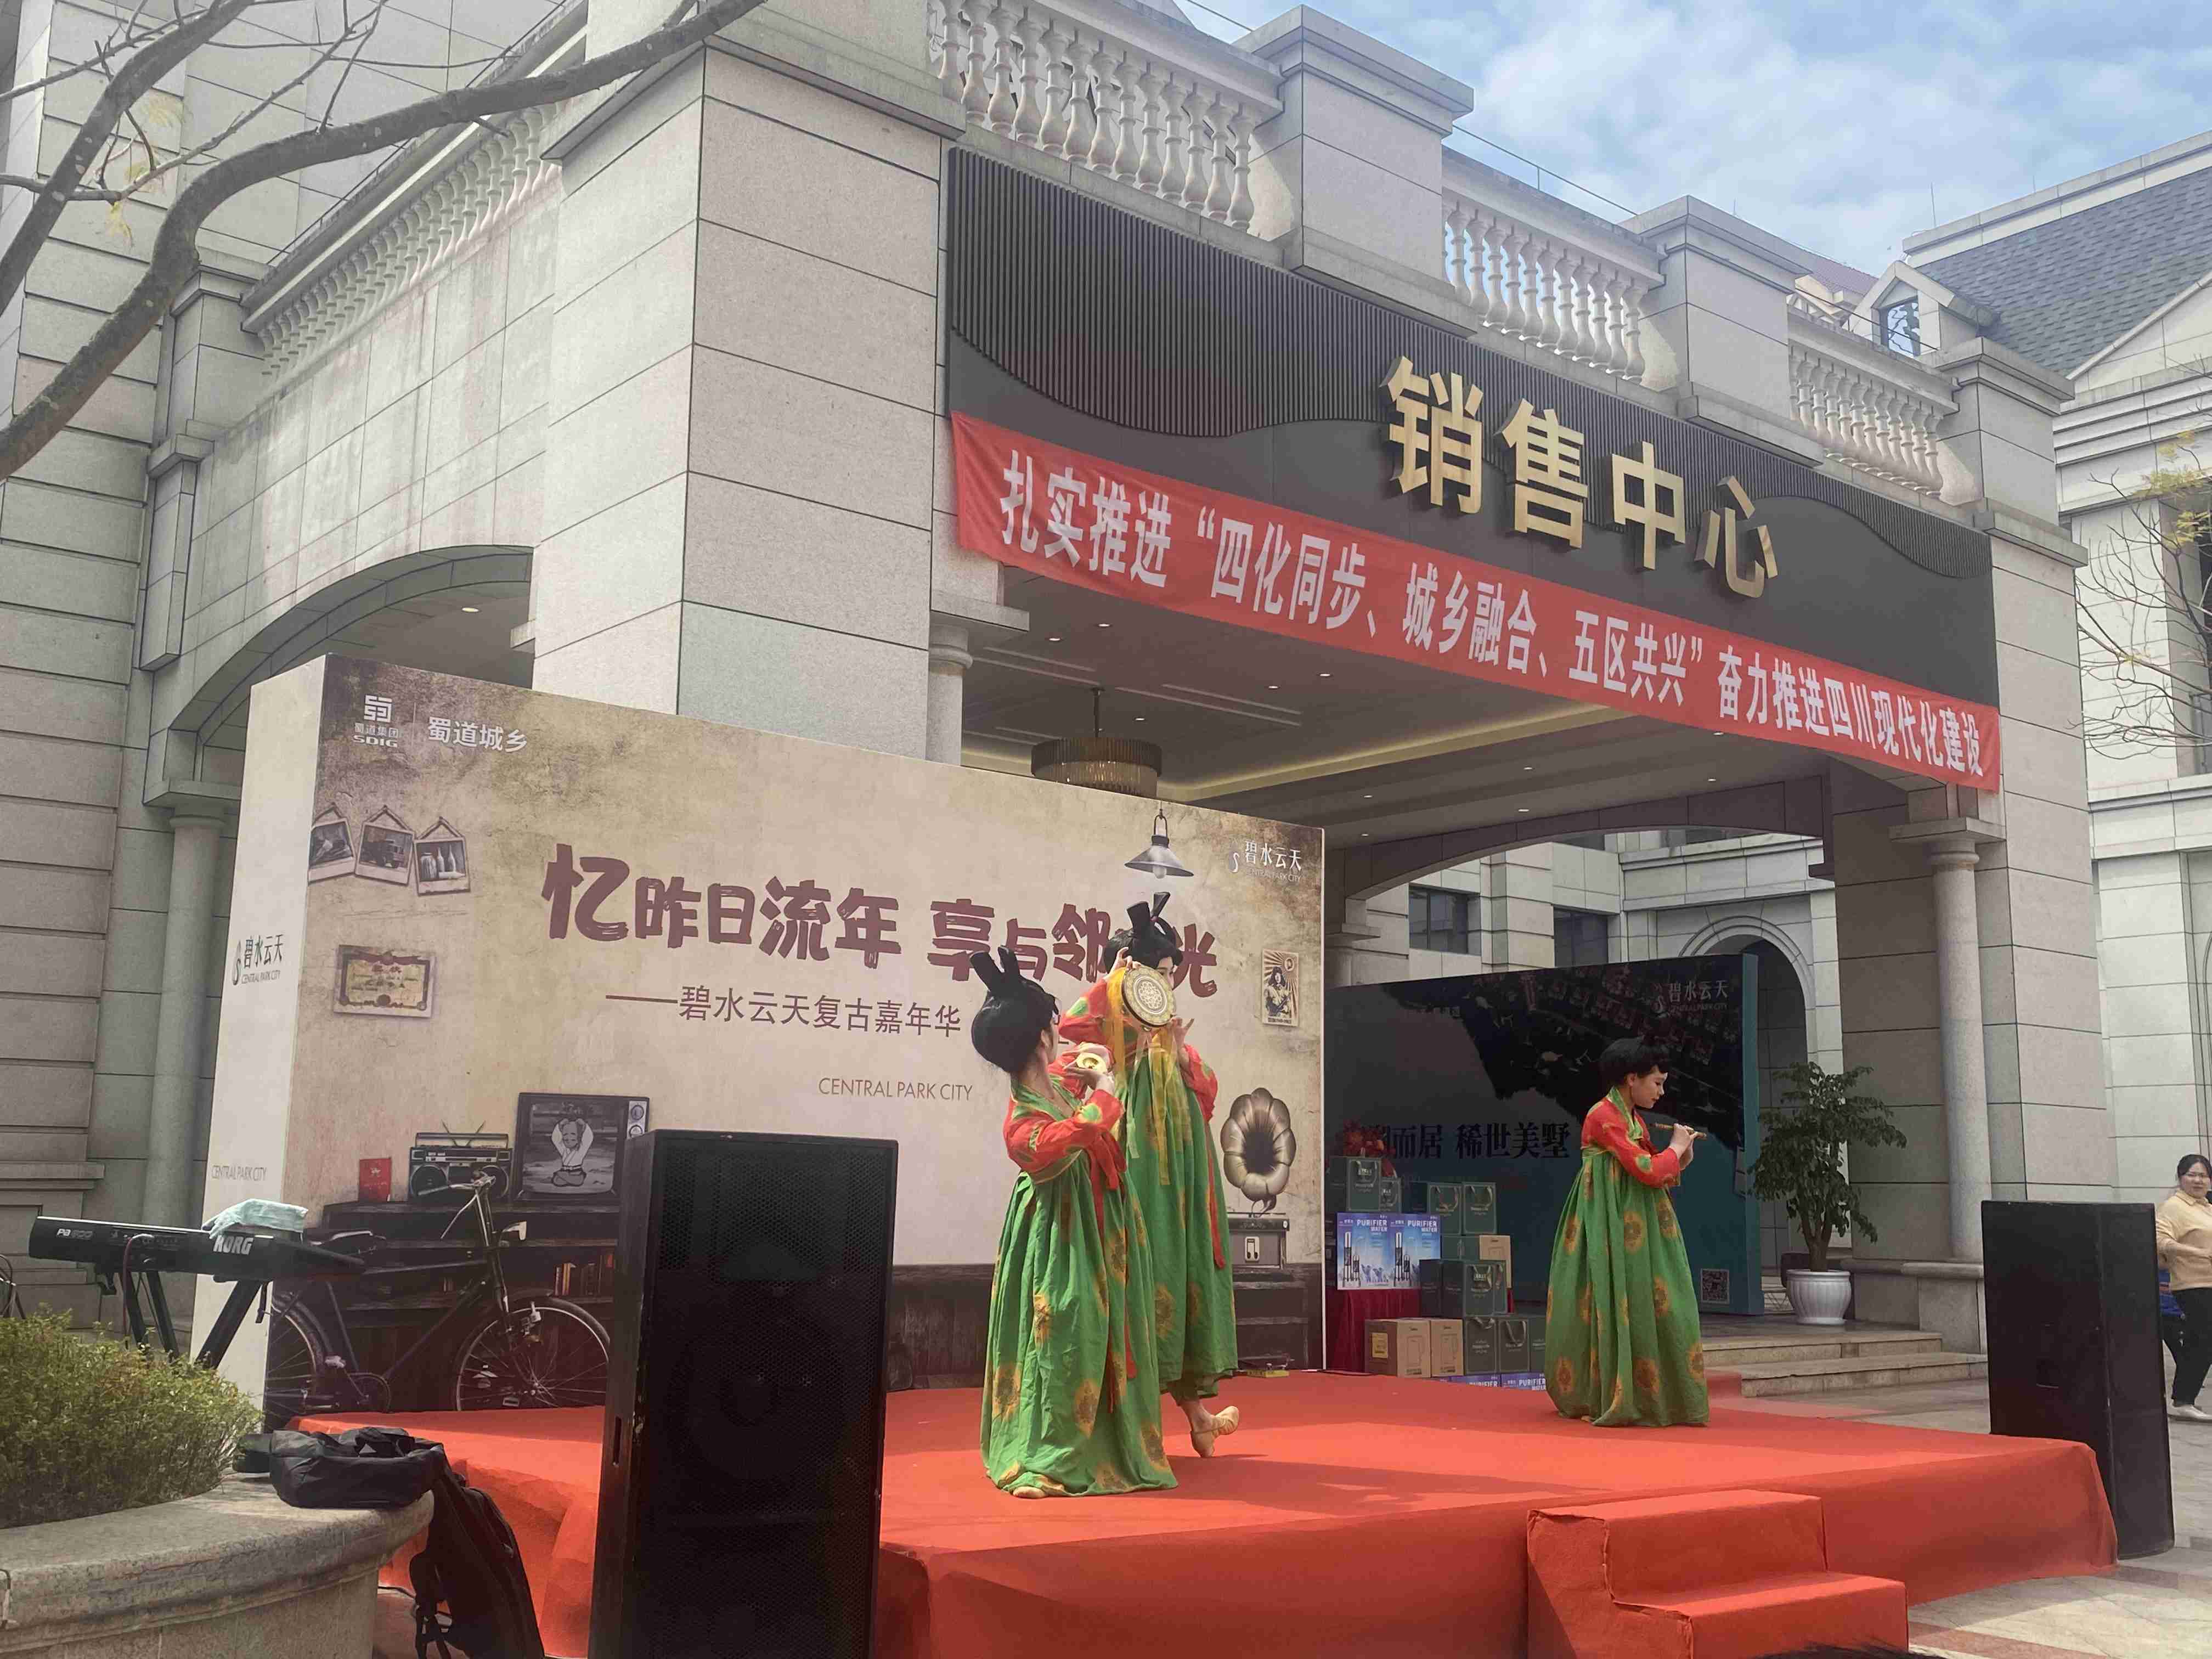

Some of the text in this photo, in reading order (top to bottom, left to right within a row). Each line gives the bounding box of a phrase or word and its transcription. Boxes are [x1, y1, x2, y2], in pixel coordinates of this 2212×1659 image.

[1381, 356, 1778, 598] 销售中心
[353, 735, 398, 747] SDIG
[354, 722, 399, 738] 蜀道集团
[427, 716, 527, 753] 蜀道城乡
[1245, 840, 1302, 871] 碧水云天
[1273, 872, 1288, 880] PARK
[1288, 874, 1301, 882] CITY
[541, 843, 1218, 997] 忆昨日流年 享与邻光
[243, 934, 284, 969] 碧水云天
[1669, 980, 1729, 1002] 碧水云天
[818, 1077, 973, 1101] CENTRAL PARK CITY
[1456, 1121, 1571, 1159] 稀世美墅
[212, 1234, 254, 1255] KORG
[1519, 1378, 1546, 1387] PURIFIER
